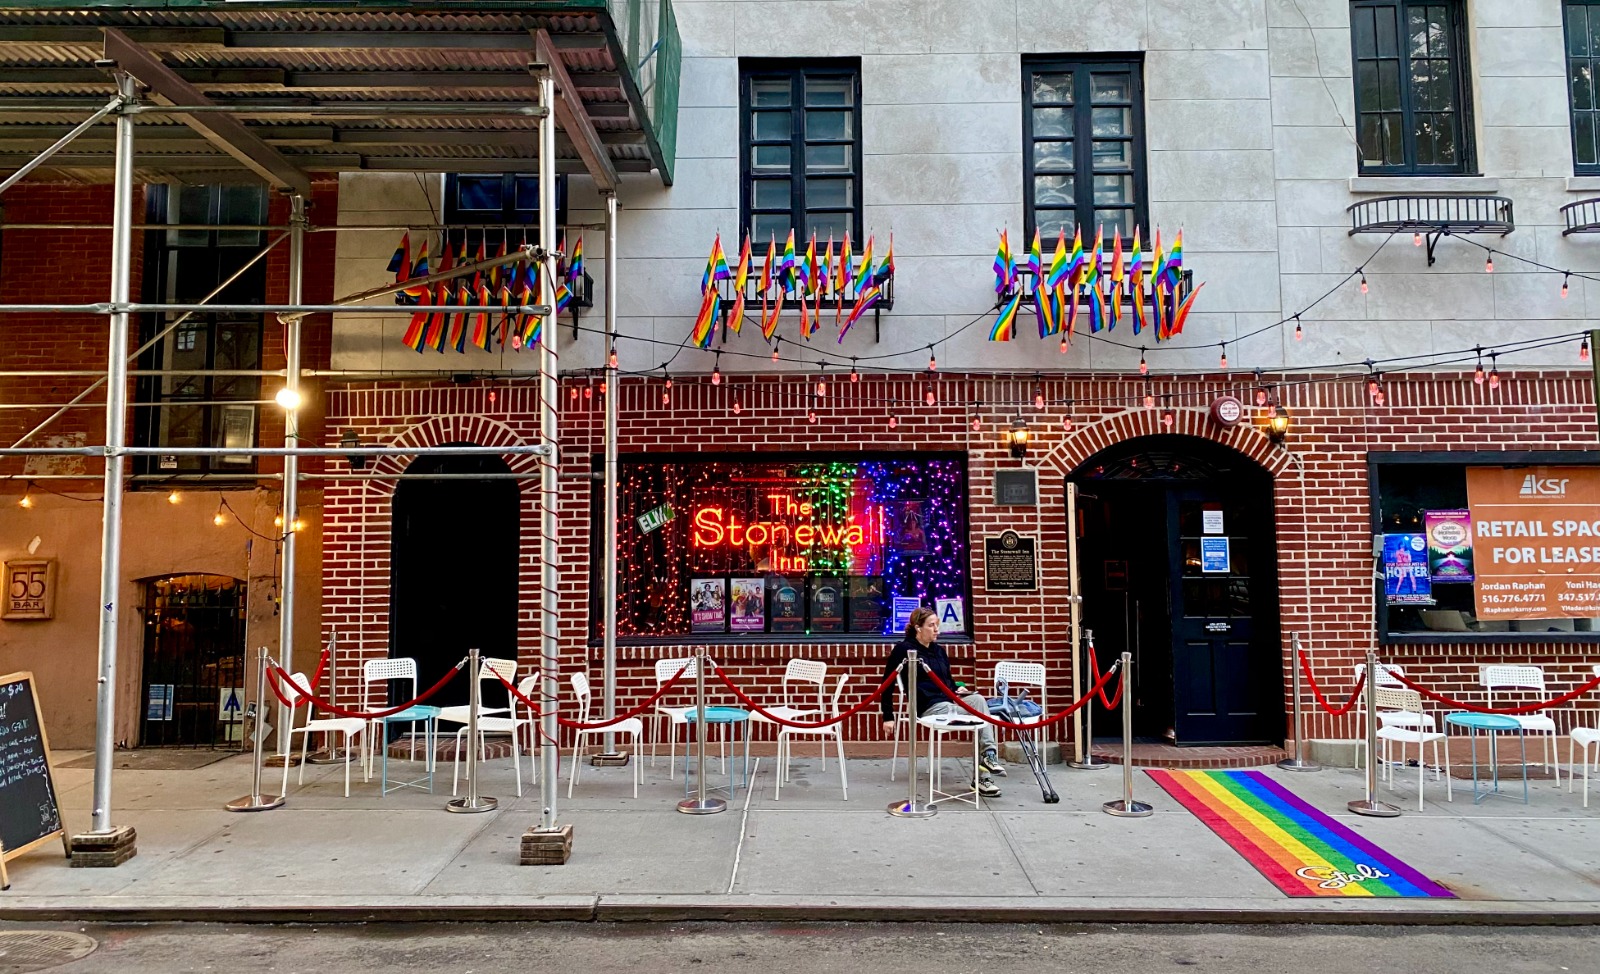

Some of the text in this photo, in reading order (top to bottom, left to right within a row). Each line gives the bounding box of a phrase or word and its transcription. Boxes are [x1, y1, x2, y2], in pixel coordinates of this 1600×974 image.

[1531, 474, 1570, 495] ksr
[766, 494, 811, 516] The
[695, 506, 884, 547] Stonewall
[1476, 520, 1549, 538] RETAIL
[773, 549, 806, 570] Inn
[1493, 546, 1600, 564] FOR LEASE
[1386, 566, 1428, 578] HOTTER
[11, 571, 46, 599] 55
[1481, 582, 1546, 591] Jordan Raphan
[1565, 581, 1585, 589] Yoni
[13, 601, 40, 609] BAR
[1482, 593, 1546, 603] 516.776.4771
[942, 602, 959, 623] A
[223, 691, 240, 711] A
[1296, 863, 1390, 889] Stoli
